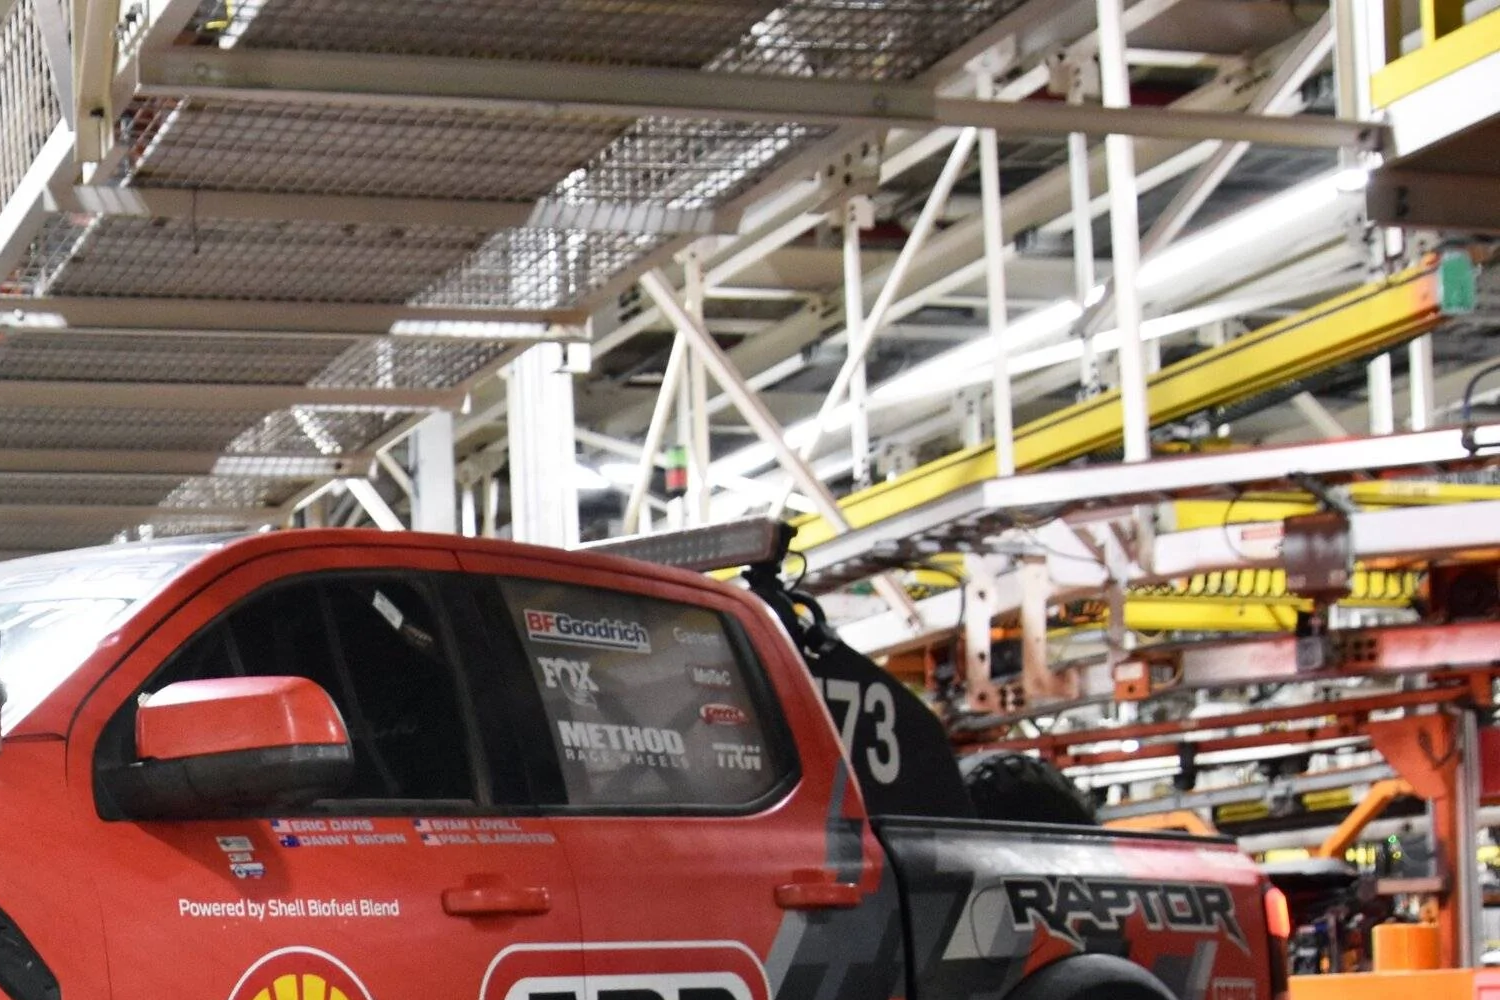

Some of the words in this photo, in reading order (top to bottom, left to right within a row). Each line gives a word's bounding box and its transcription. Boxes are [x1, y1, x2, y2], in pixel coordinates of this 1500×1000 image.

[526, 612, 647, 643] BFGoodrich
[537, 656, 600, 692] FOX
[557, 720, 685, 755] METHOD
[812, 677, 901, 784] 73
[330, 819, 374, 832] DAVIS
[178, 899, 245, 917] Powered
[247, 899, 265, 922] by
[268, 899, 304, 917] Shell
[308, 899, 357, 917] Biofuel
[360, 899, 400, 917] Blend
[1000, 875, 1250, 954] RAPTOR
